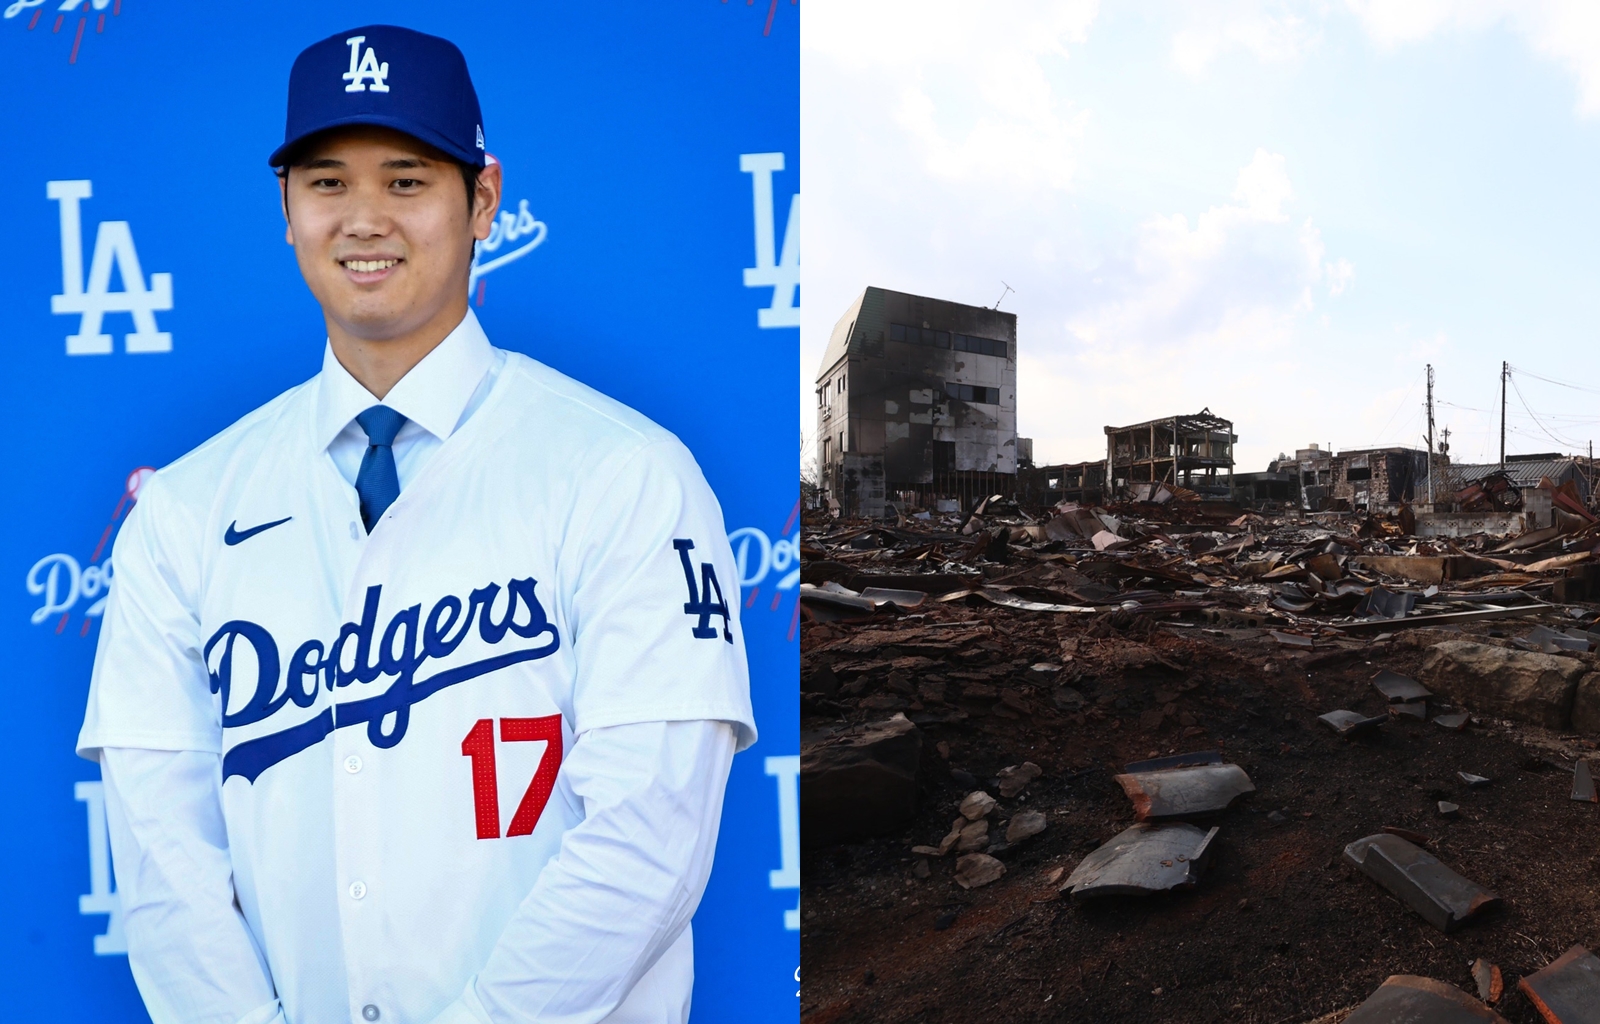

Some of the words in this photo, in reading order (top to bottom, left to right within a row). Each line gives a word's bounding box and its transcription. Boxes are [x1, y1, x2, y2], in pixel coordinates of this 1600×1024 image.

[343, 36, 390, 93] LA
[46, 180, 173, 355] LA
[673, 538, 733, 644] LA
[204, 577, 560, 786] Dodgers
[461, 714, 563, 840] 17
